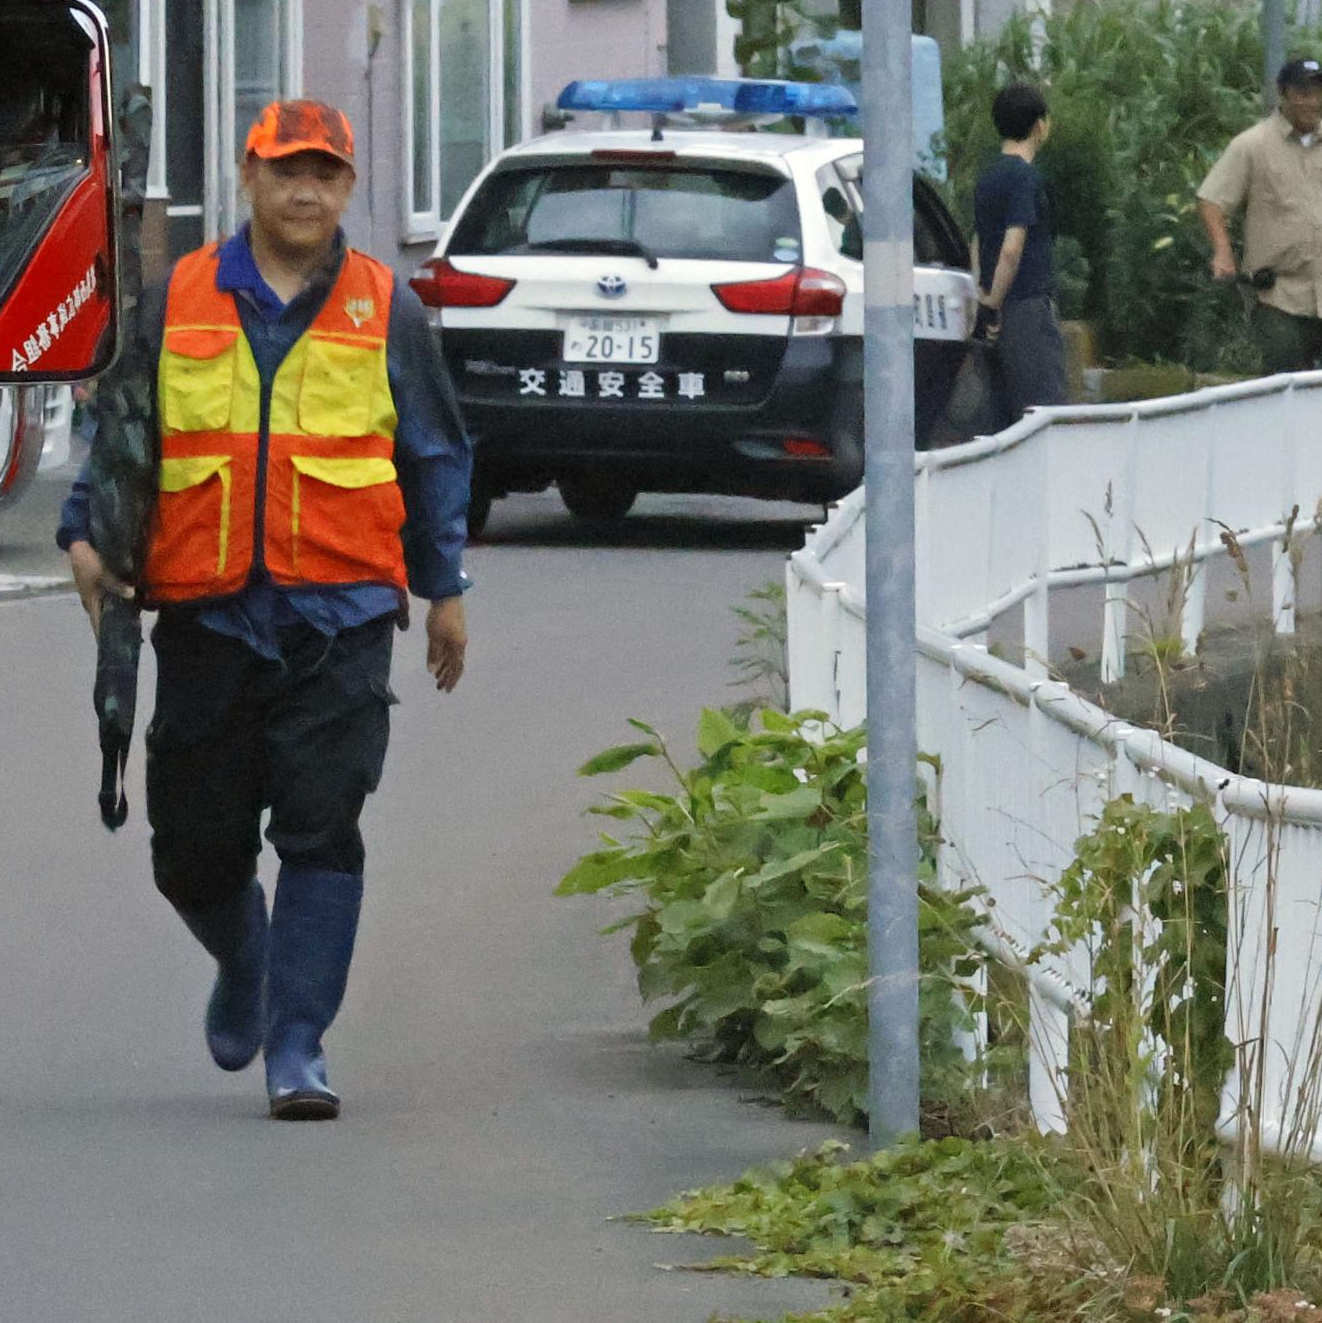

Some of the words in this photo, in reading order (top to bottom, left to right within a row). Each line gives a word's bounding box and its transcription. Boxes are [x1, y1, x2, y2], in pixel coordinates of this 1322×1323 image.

[586, 335, 653, 359] 20-15
[518, 367, 706, 400] 交通安全車
